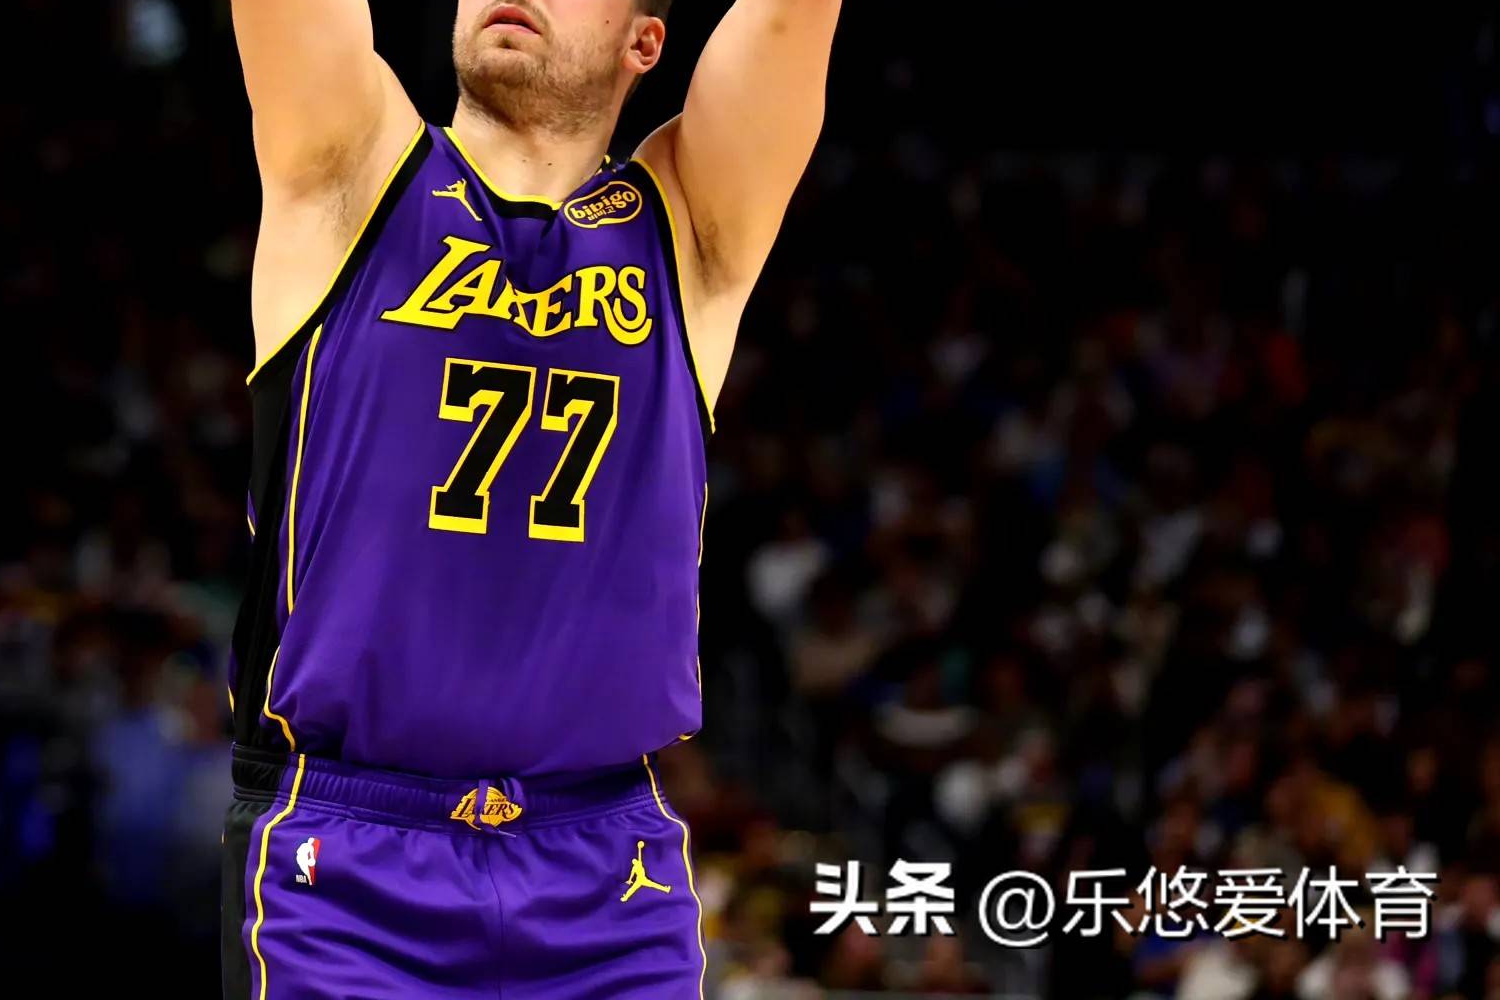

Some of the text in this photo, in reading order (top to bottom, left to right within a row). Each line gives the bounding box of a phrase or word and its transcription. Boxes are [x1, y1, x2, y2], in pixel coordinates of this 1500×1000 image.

[570, 190, 636, 219] bibigo
[380, 235, 653, 346] LAKERS
[428, 357, 621, 542] 77
[452, 796, 519, 821] LAERS
